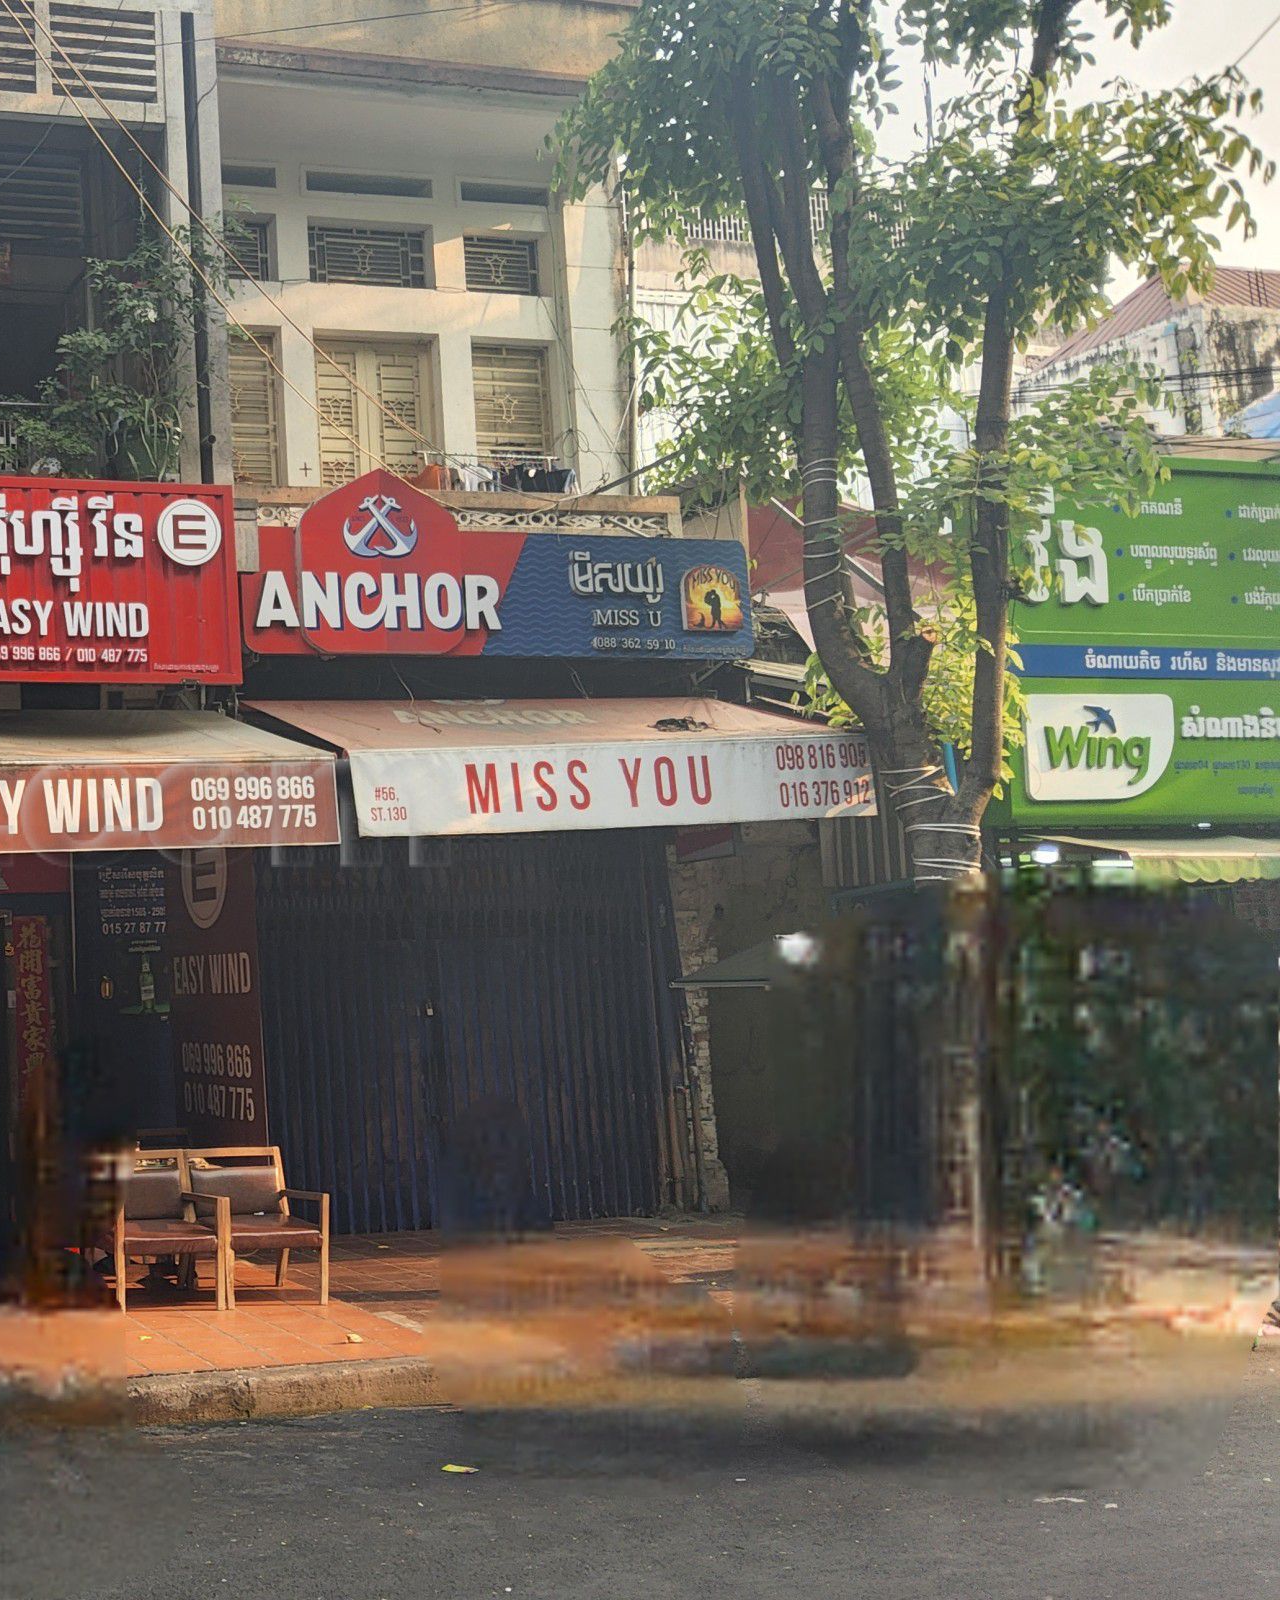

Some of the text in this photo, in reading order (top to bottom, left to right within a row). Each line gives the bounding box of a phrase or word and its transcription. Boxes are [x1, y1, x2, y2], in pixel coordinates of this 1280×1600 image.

[692, 567, 714, 589] MISS
[255, 570, 502, 632] ANCHOR
[64, 601, 150, 638] WIND
[594, 608, 662, 627] MISS U
[12, 646, 35, 661] 996
[38, 646, 61, 662] 866
[76, 647, 97, 663] 010
[100, 647, 122, 663] 487
[125, 648, 148, 663] 775
[621, 637, 642, 650] 362
[646, 639, 660, 650] 59
[664, 639, 676, 650] 10
[775, 744, 805, 770] 098
[807, 743, 836, 769] 816
[1044, 725, 1151, 786] Wing
[190, 775, 316, 801] 069 996 866
[373, 786, 400, 802] #56,
[463, 755, 713, 815] MISS YOU
[779, 779, 871, 807] 016 376 912
[42, 777, 164, 834] WIND
[192, 803, 317, 830] 010 487 775
[370, 806, 407, 822] ST.130
[102, 921, 167, 935] 015 27 87 77
[173, 951, 252, 995] EASY WIND
[181, 1042, 252, 1078] 069 996 866
[183, 1081, 255, 1122] 010 487 775
